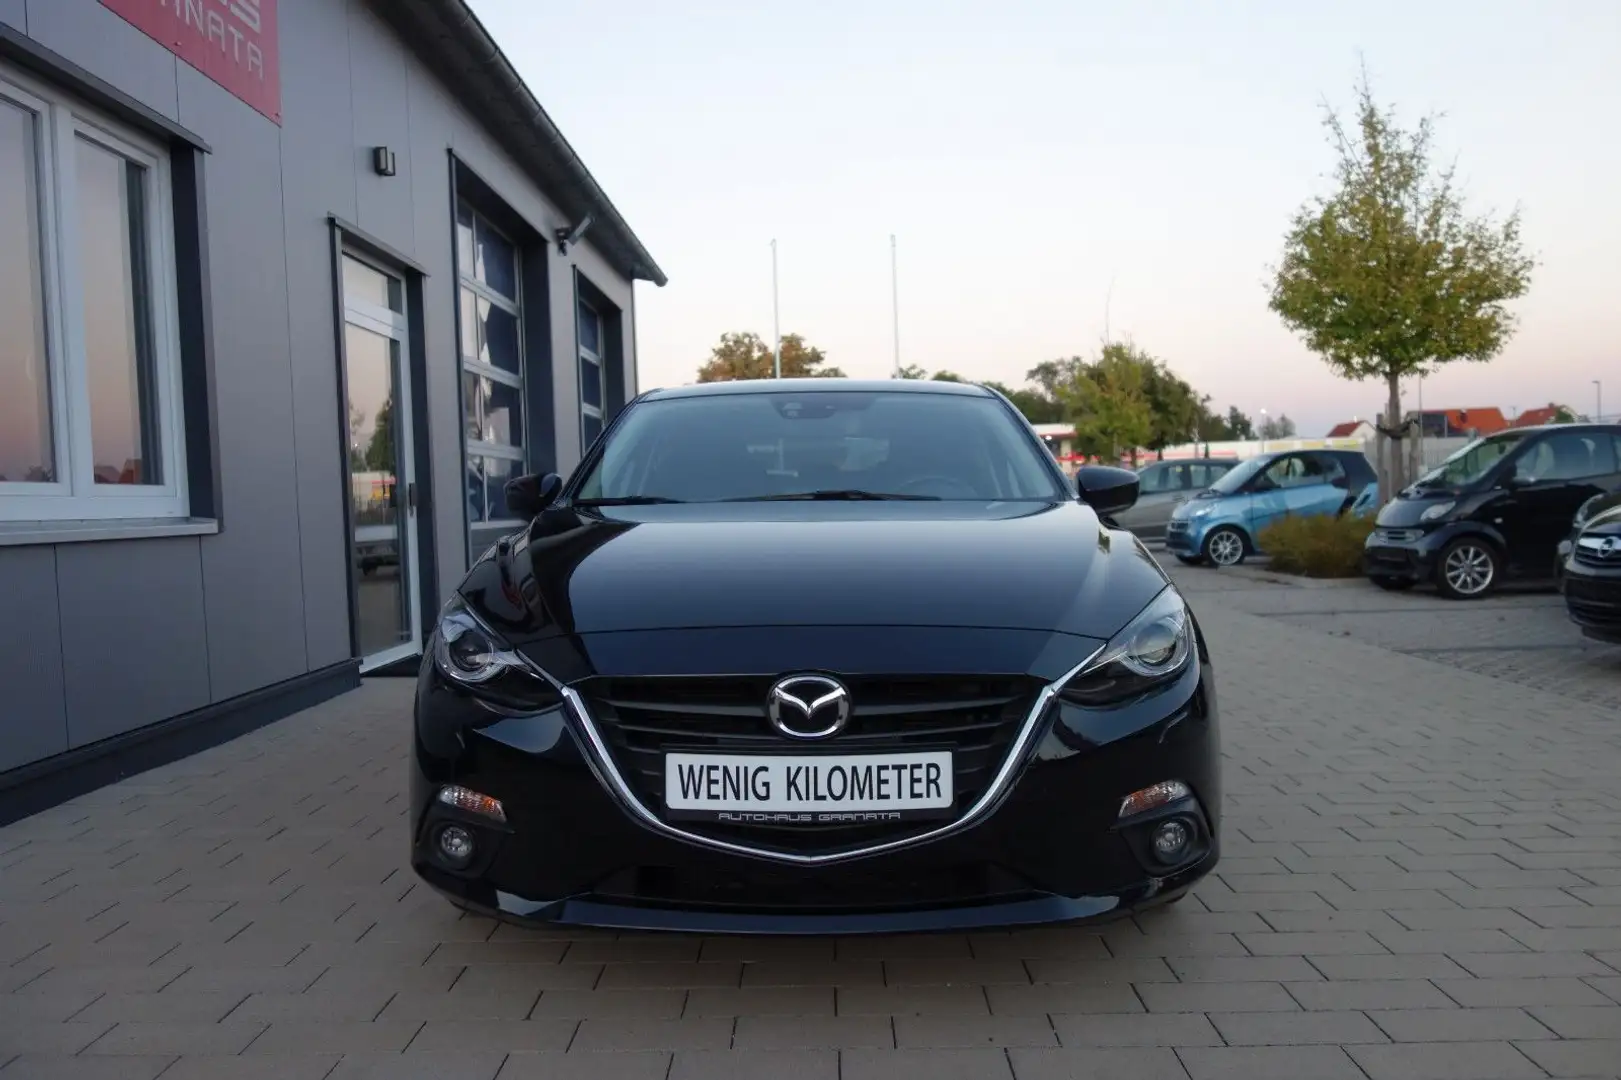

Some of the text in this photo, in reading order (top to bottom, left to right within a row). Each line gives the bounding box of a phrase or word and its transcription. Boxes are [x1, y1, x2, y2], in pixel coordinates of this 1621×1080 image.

[678, 763, 941, 801] WENIG KILOMETER
[718, 812, 901, 821] AUTOHAUS GRANATA
